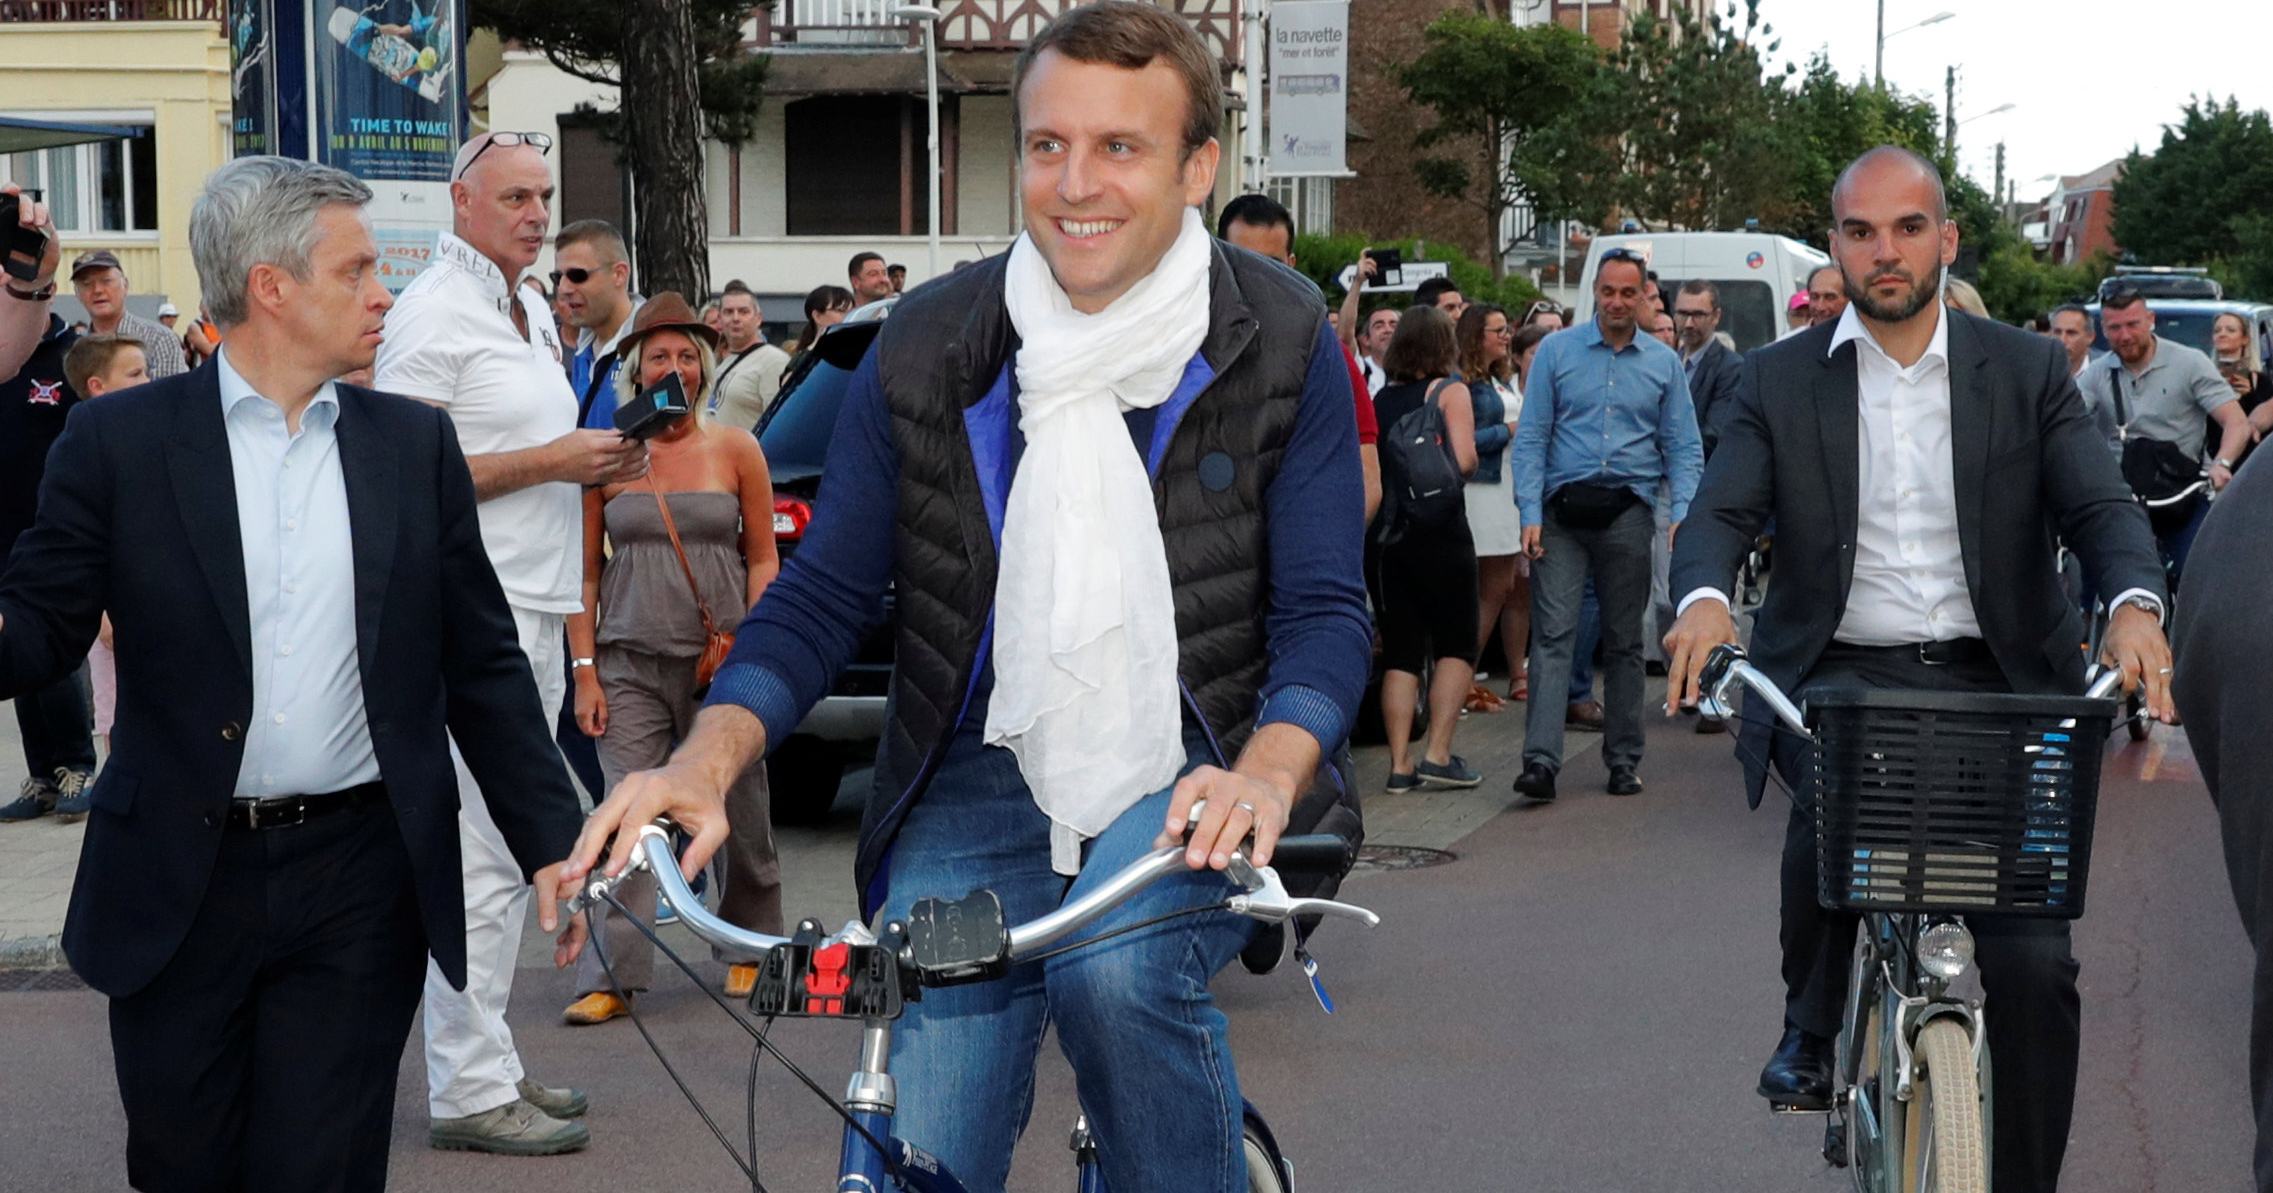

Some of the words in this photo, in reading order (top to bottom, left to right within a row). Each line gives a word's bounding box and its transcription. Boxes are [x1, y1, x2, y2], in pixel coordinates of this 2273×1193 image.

[1276, 27, 1288, 43] la
[1291, 26, 1342, 43] navette
[350, 118, 391, 133] TIME
[394, 119, 412, 133] TO
[360, 135, 386, 150] AVRIL
[385, 247, 431, 260] 2017
